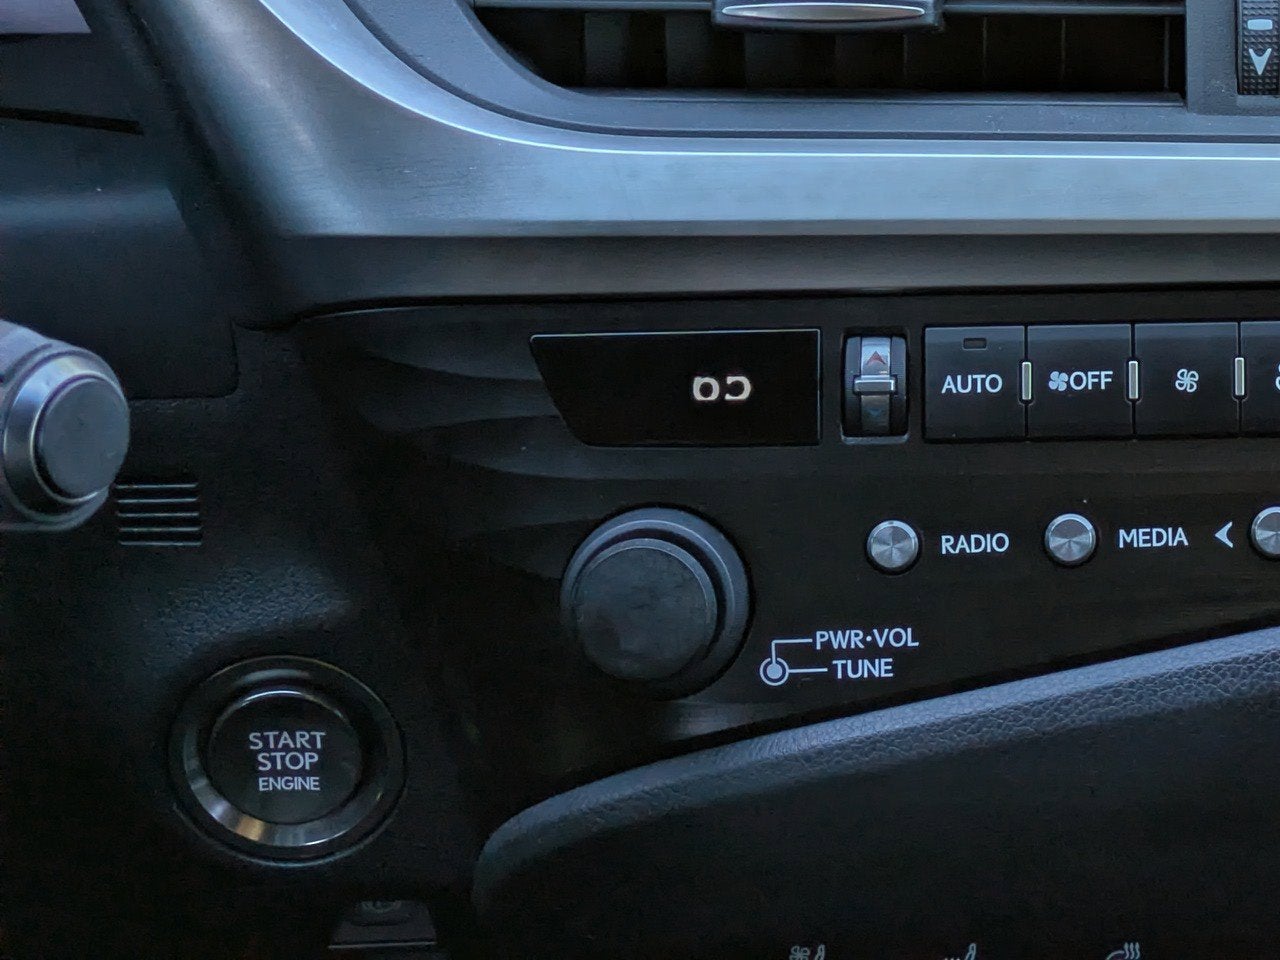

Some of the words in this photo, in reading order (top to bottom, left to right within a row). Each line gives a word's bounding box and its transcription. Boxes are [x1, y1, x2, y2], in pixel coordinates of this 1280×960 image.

[941, 373, 1003, 395] AUTO
[1069, 370, 1113, 391] OFF
[941, 533, 1010, 555] RADIO
[1118, 527, 1189, 549] MEDIA
[832, 658, 893, 680] TUNE
[249, 731, 326, 750] START
[257, 752, 319, 770] STOP
[258, 777, 321, 792] ENGINE
